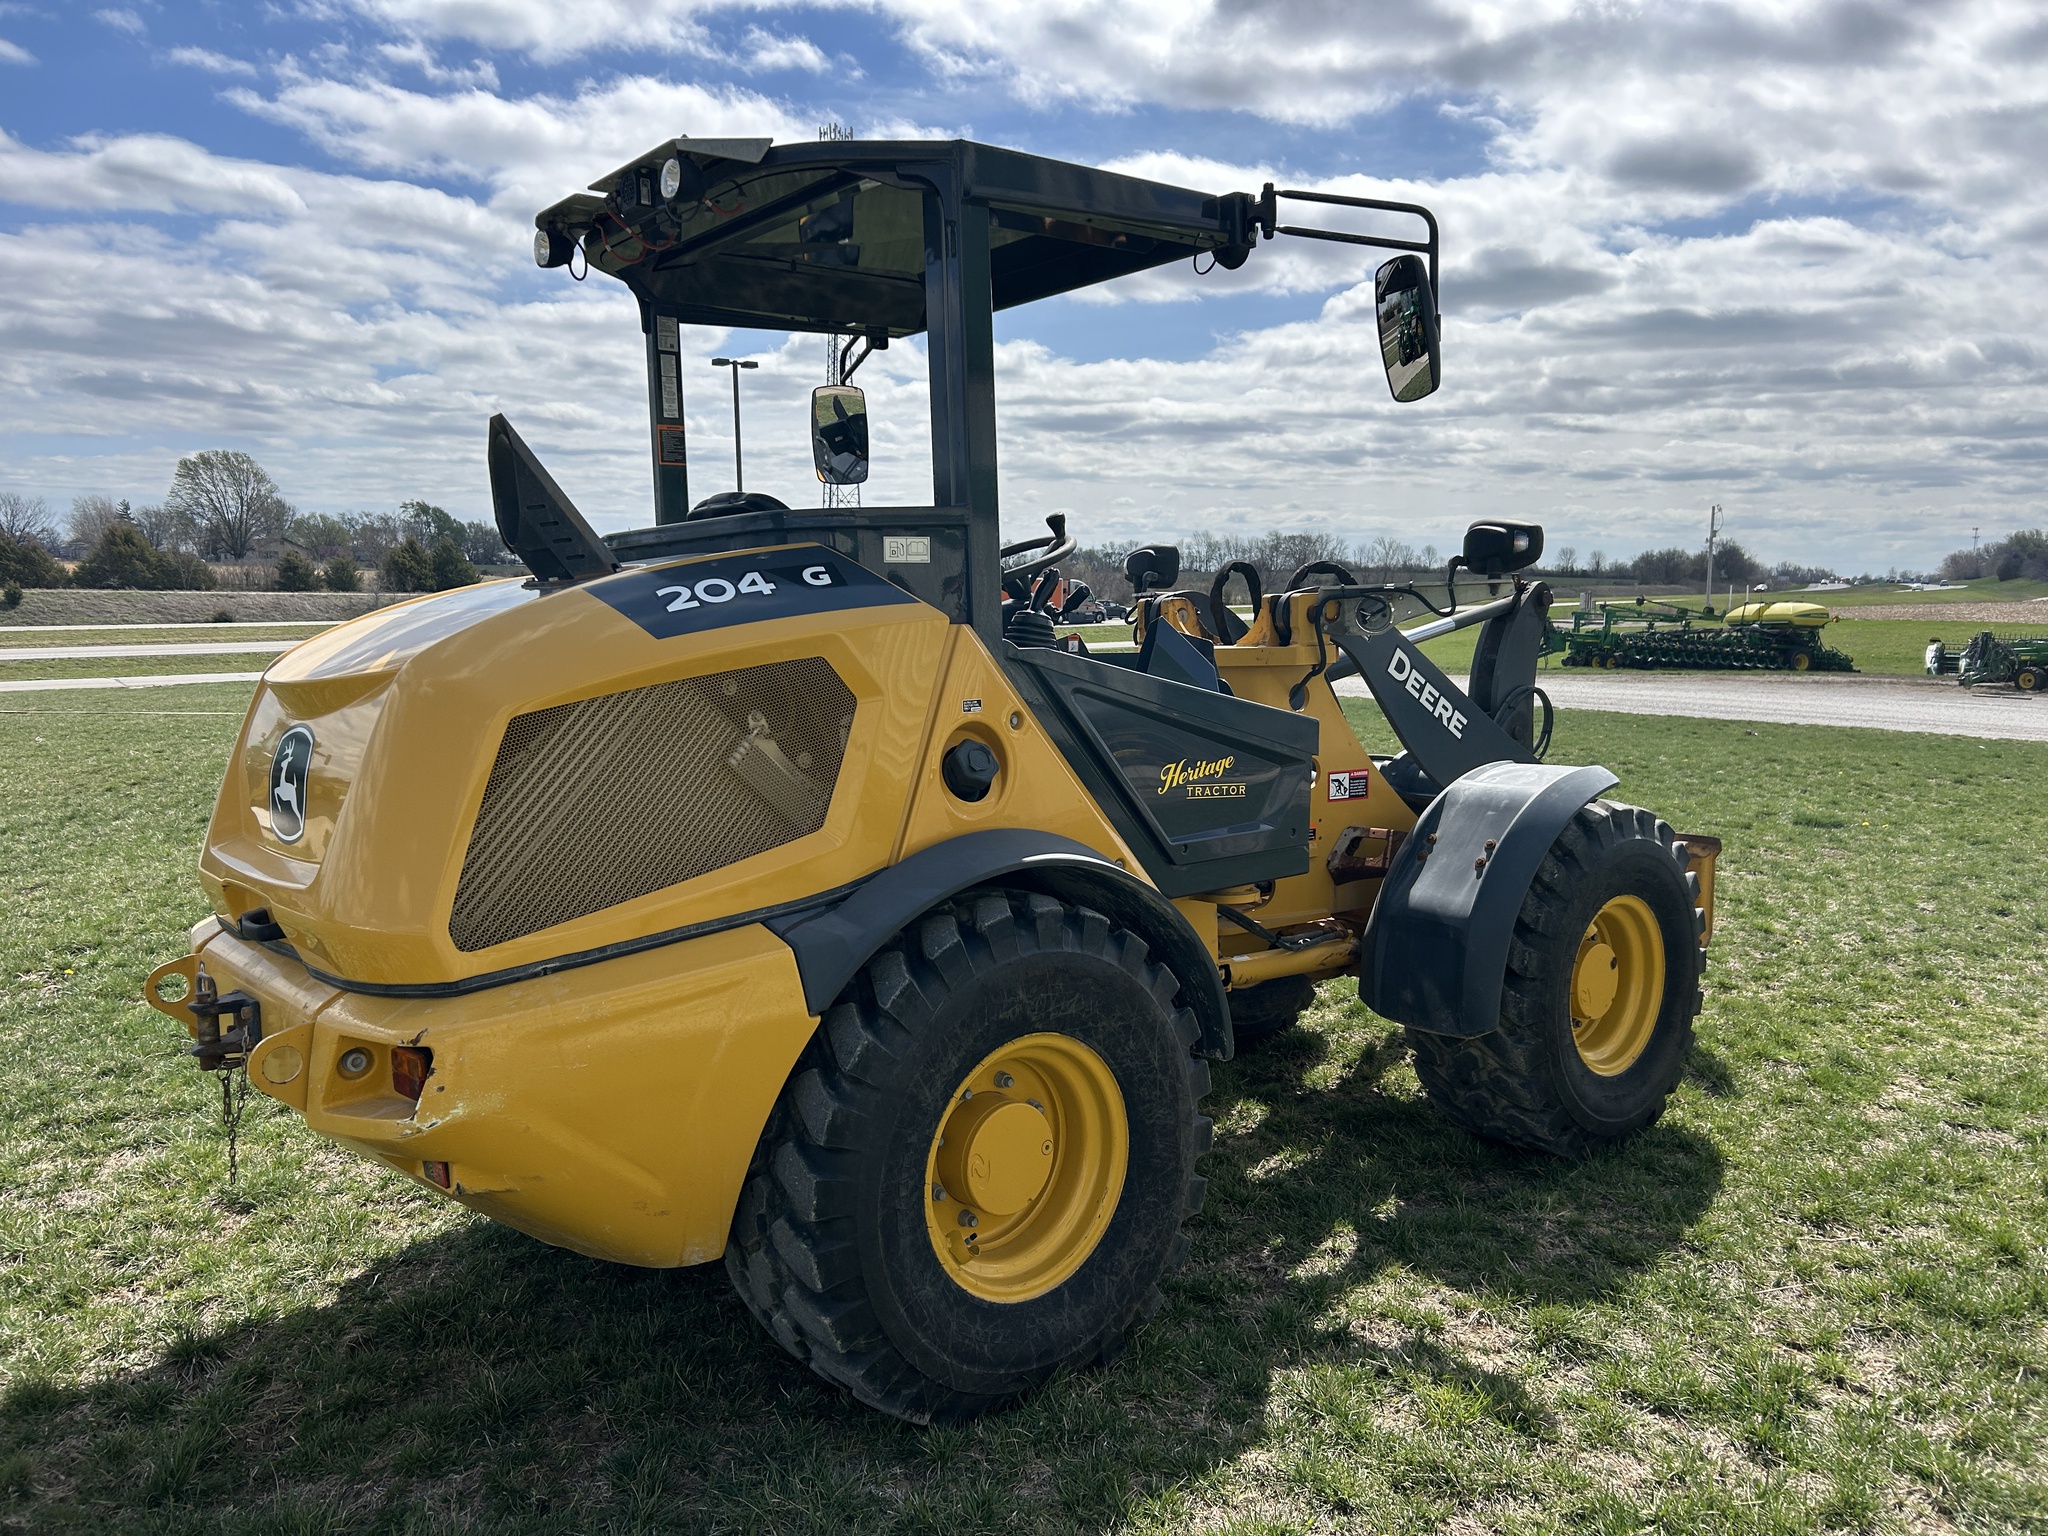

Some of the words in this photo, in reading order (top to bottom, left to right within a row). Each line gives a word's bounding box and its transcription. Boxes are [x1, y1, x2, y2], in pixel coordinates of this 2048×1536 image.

[655, 571, 777, 613] 204
[802, 566, 832, 586] G
[1387, 647, 1468, 740] DEERE
[1157, 755, 1235, 795] Heritage
[1186, 785, 1246, 797] TRACTOR
